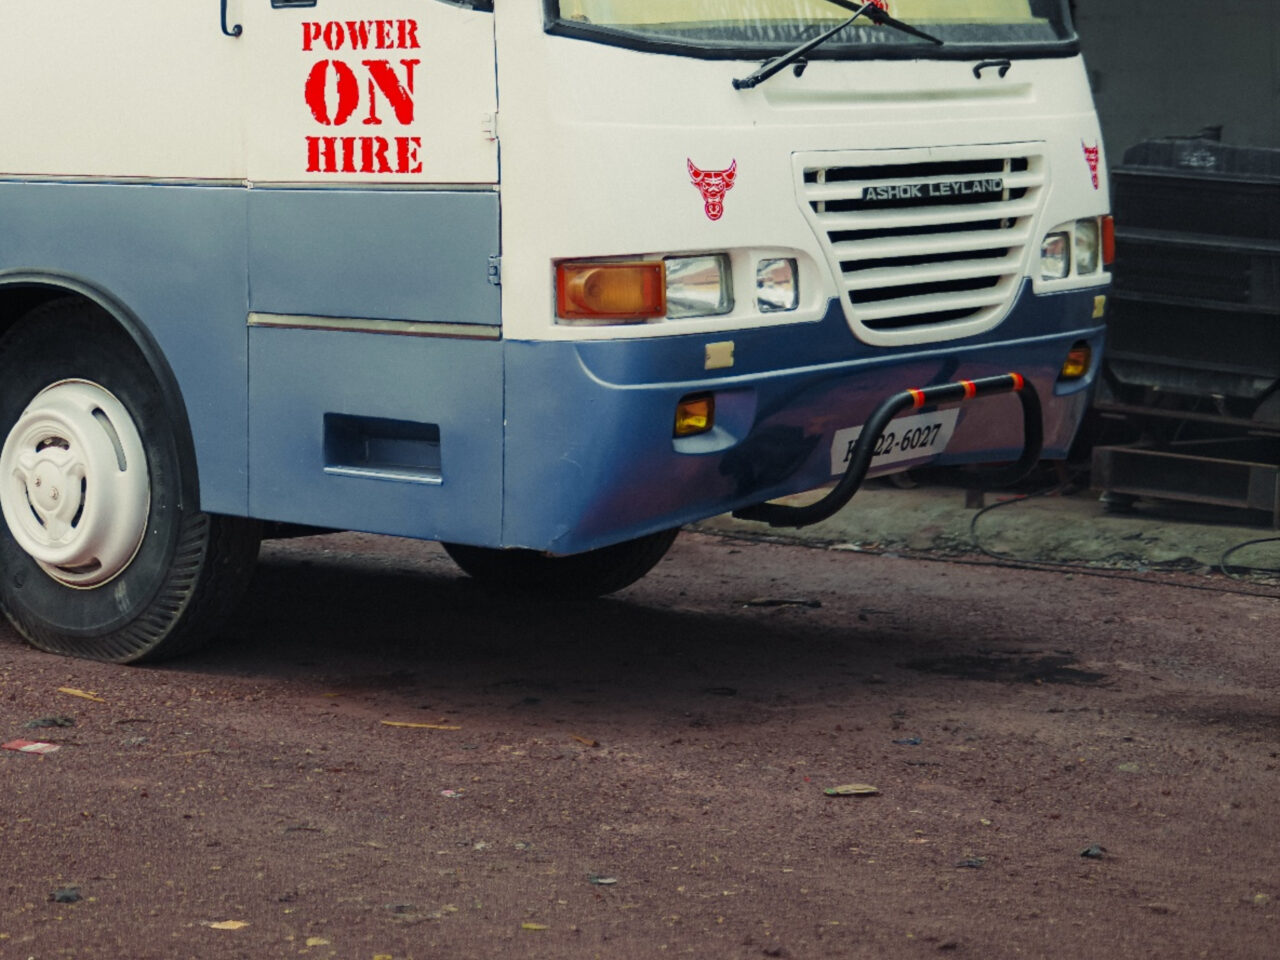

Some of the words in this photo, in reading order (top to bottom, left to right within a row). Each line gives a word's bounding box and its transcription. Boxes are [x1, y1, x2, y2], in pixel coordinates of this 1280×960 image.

[301, 19, 421, 51] POWER
[304, 59, 421, 126] ON
[305, 136, 423, 174] HIRE
[865, 185, 922, 201] ASHOK
[929, 178, 1003, 196] LEYLAND
[843, 423, 942, 462] K22-6027
